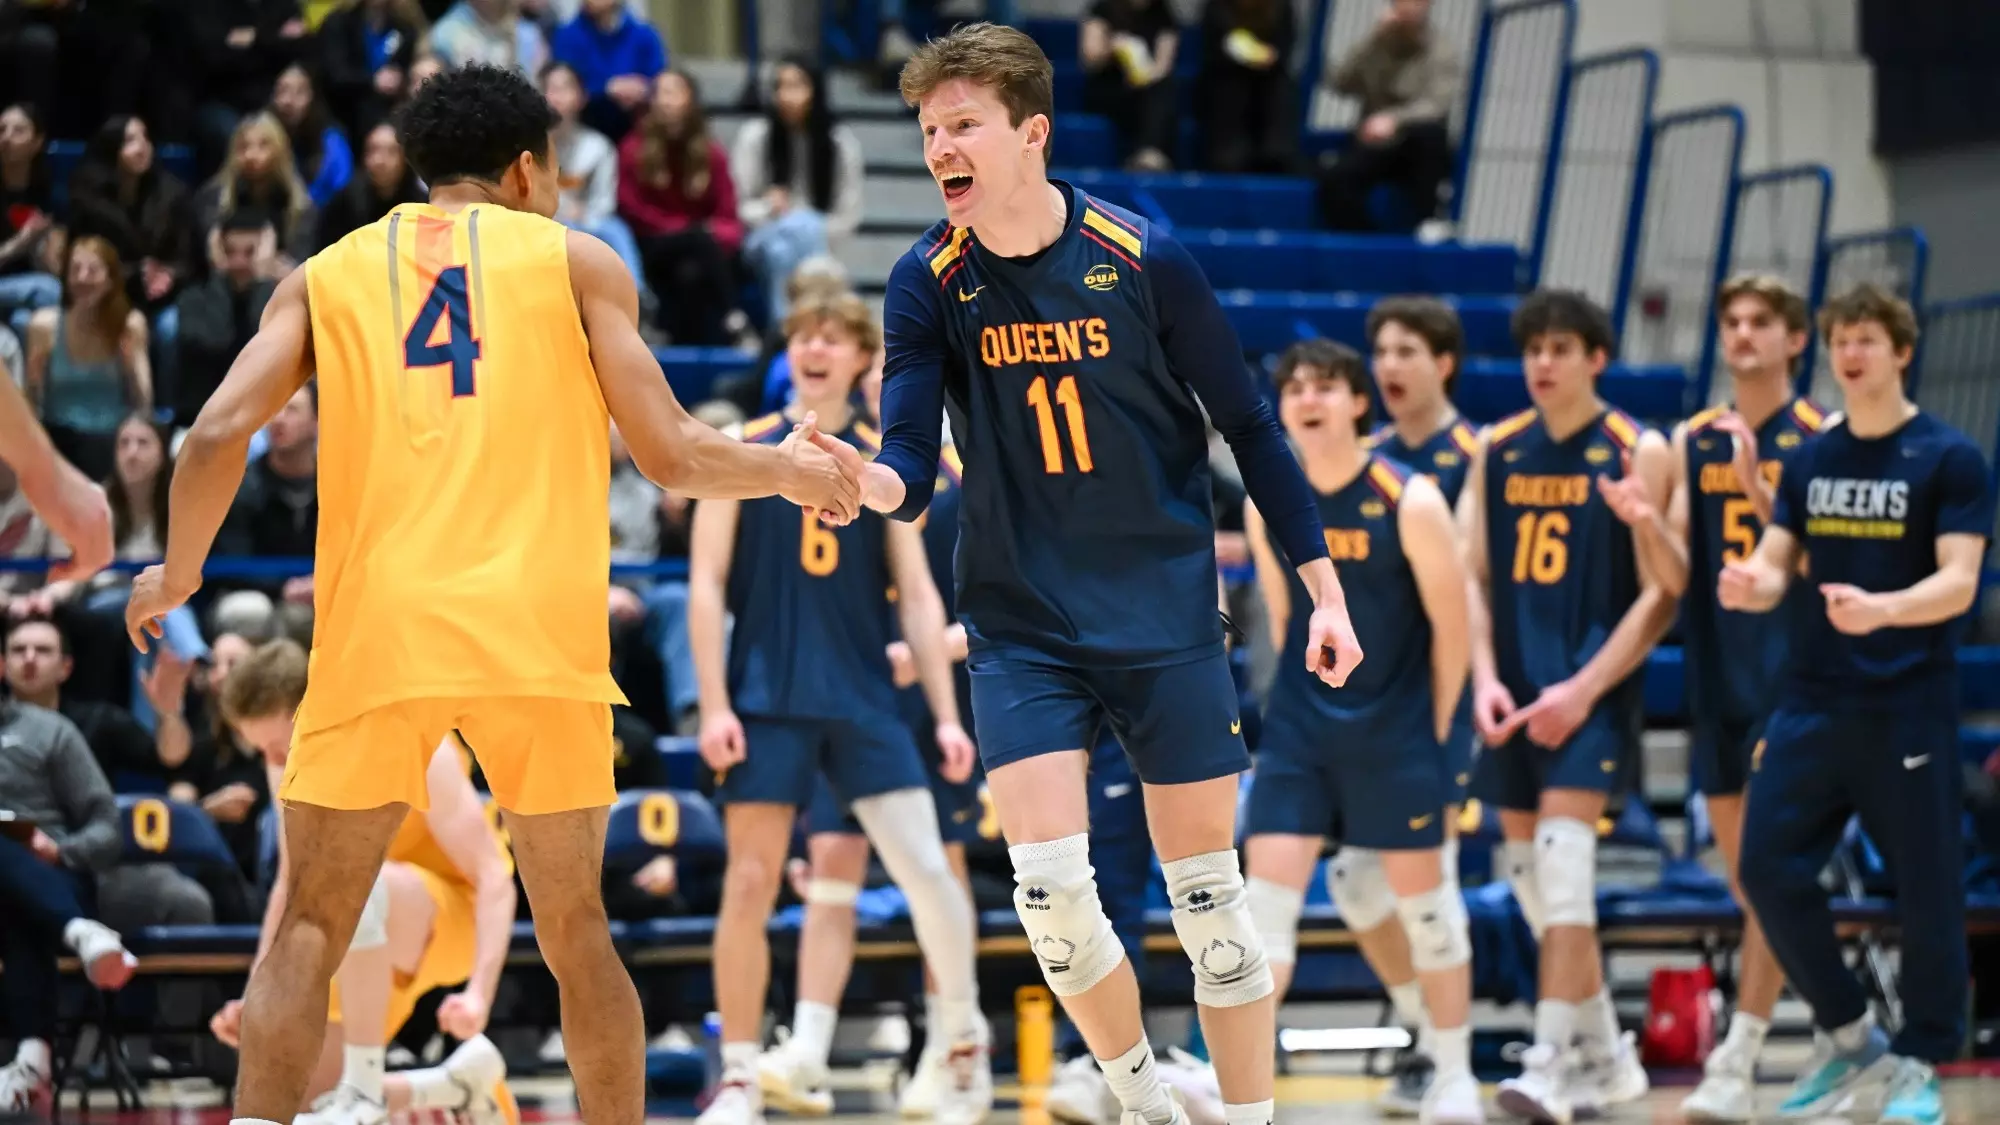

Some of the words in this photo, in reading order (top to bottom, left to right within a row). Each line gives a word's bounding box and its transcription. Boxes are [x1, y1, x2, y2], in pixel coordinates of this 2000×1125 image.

[1084, 272, 1118, 285] OUA
[402, 264, 481, 398] 4
[981, 317, 1110, 367] QUEEN'S
[1027, 375, 1094, 474] 11
[801, 506, 839, 577] 6
[1512, 510, 1571, 585] 16
[1722, 499, 1757, 565] 5
[133, 799, 169, 854] Q
[638, 792, 678, 847] Q
